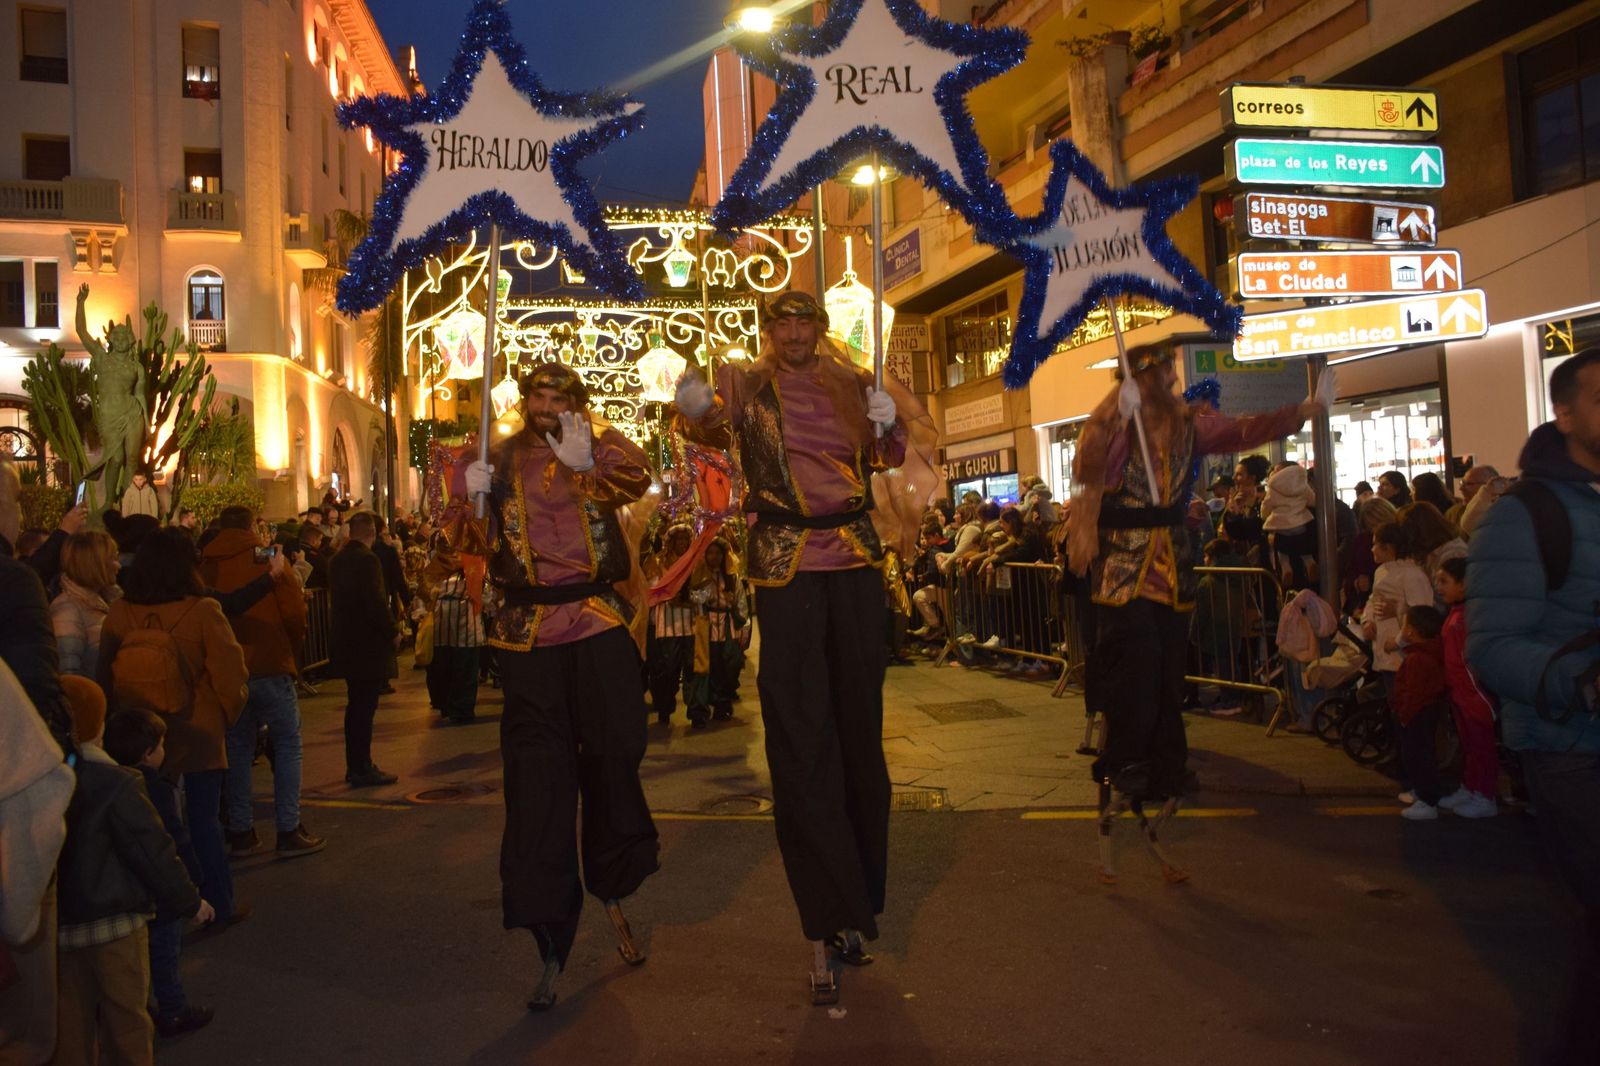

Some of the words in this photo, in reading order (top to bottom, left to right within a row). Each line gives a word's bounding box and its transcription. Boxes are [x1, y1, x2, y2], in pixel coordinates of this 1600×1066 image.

[825, 63, 923, 105] REAL
[1236, 101, 1304, 115] correos
[431, 128, 548, 172] HERALDO
[1241, 156, 1277, 169] plaza
[1284, 156, 1301, 169] de
[1308, 156, 1329, 169] los
[1335, 154, 1388, 172] Reyes
[1251, 198, 1328, 219] sinagoga
[1251, 217, 1307, 236] Bet-El
[895, 249, 920, 270] DENTAL
[1053, 226, 1140, 276] ILUSIÓN
[1243, 261, 1290, 272] museo
[1298, 259, 1316, 271] de
[1244, 275, 1267, 291] La
[1278, 273, 1347, 291] Ciudad
[1243, 319, 1288, 336] glesia
[1296, 315, 1316, 328] de
[889, 338, 918, 350] HINO
[1240, 338, 1280, 354] San
[1290, 326, 1395, 350] Francisco
[941, 462, 961, 481] SAT
[965, 454, 997, 477] GURU
